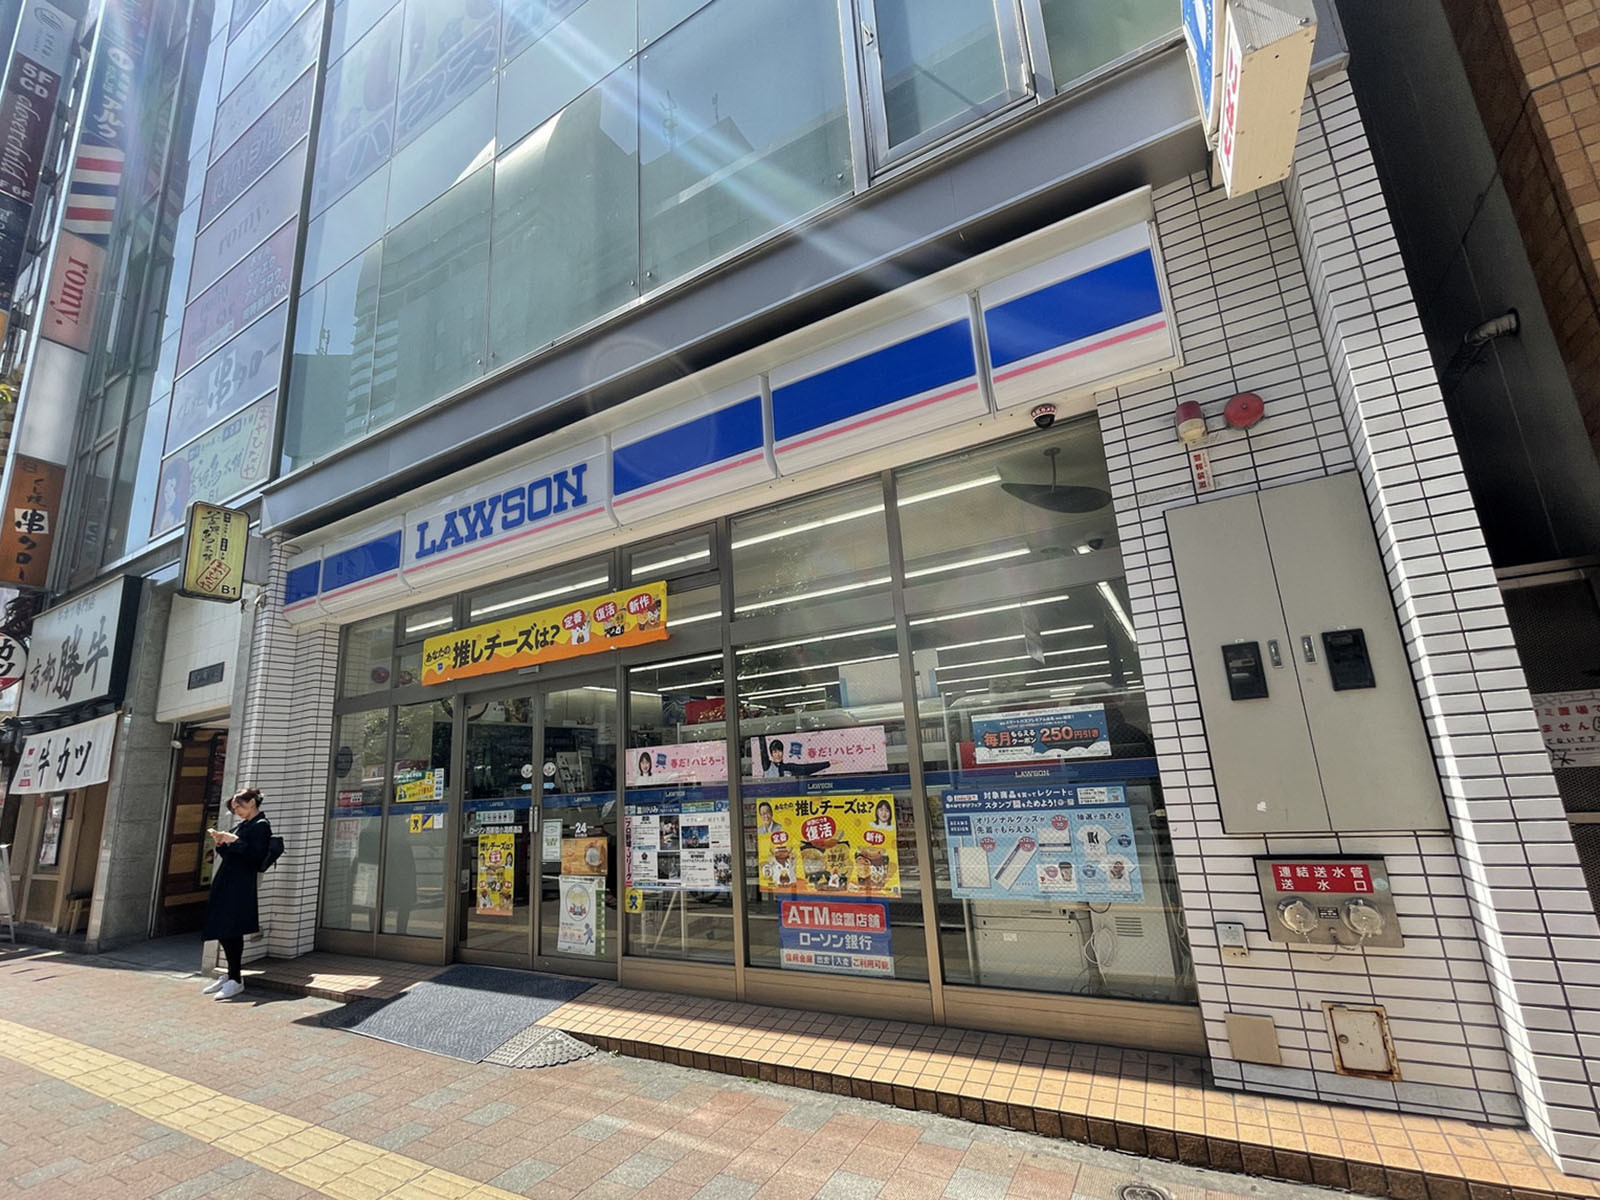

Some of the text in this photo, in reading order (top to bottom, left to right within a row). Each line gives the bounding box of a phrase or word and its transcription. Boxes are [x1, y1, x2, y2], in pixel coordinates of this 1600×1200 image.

[415, 462, 588, 559] LAWSON
[221, 584, 237, 595] B1
[594, 602, 617, 622] 復活
[628, 596, 650, 615] 新作
[564, 610, 585, 629] 定番
[426, 622, 562, 671] あなたの 推しチーズは?
[983, 731, 1011, 748] 毎月
[1011, 737, 1037, 745] クーポン
[38, 738, 93, 789] 牛カツ
[1014, 770, 1050, 778] LAWSON
[795, 798, 875, 817] 推しチーズは?
[575, 821, 588, 834] 24
[804, 822, 834, 842] 復活
[1278, 866, 1364, 879] 連結送水管
[1281, 879, 1368, 892] 送水口
[799, 932, 873, 951] ローソン銀行
